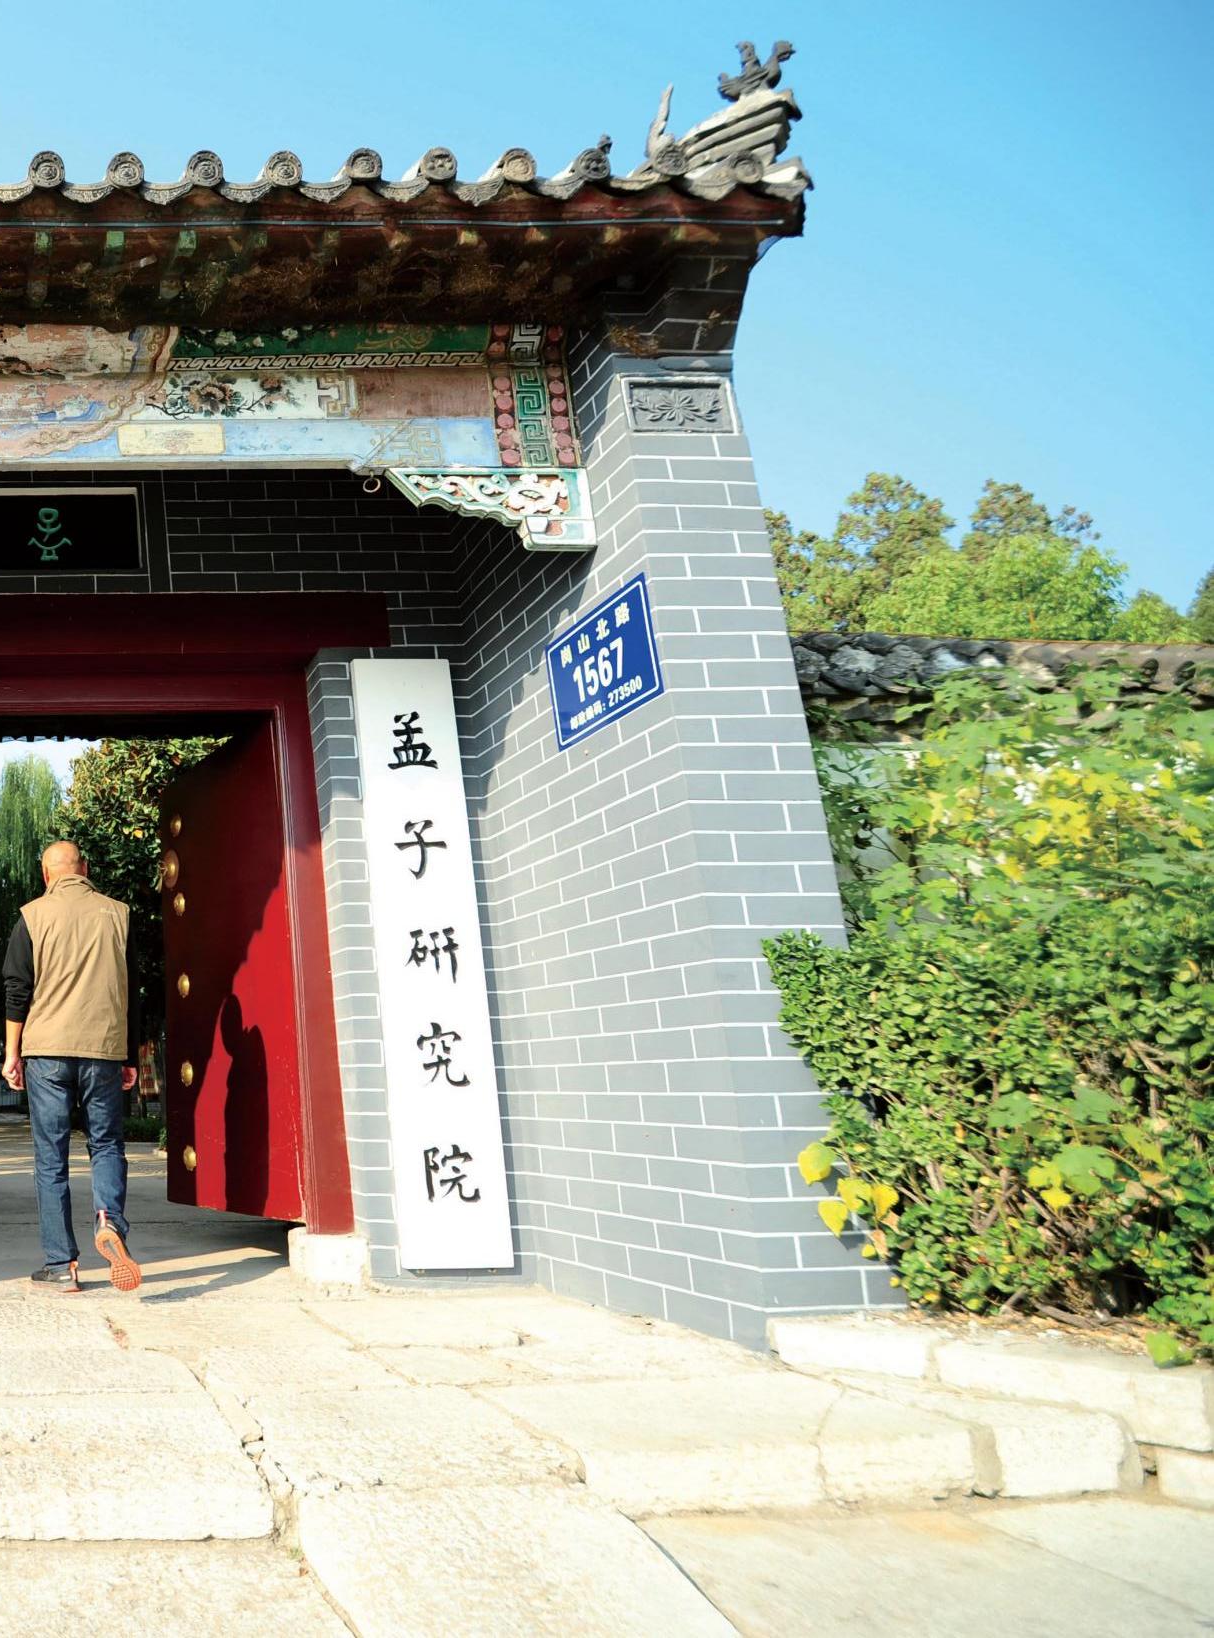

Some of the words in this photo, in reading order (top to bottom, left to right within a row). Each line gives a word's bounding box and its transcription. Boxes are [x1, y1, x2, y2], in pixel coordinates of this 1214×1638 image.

[572, 636, 624, 703] 1567
[607, 675, 643, 708] 273500
[387, 711, 481, 1205] 孟子研究院
